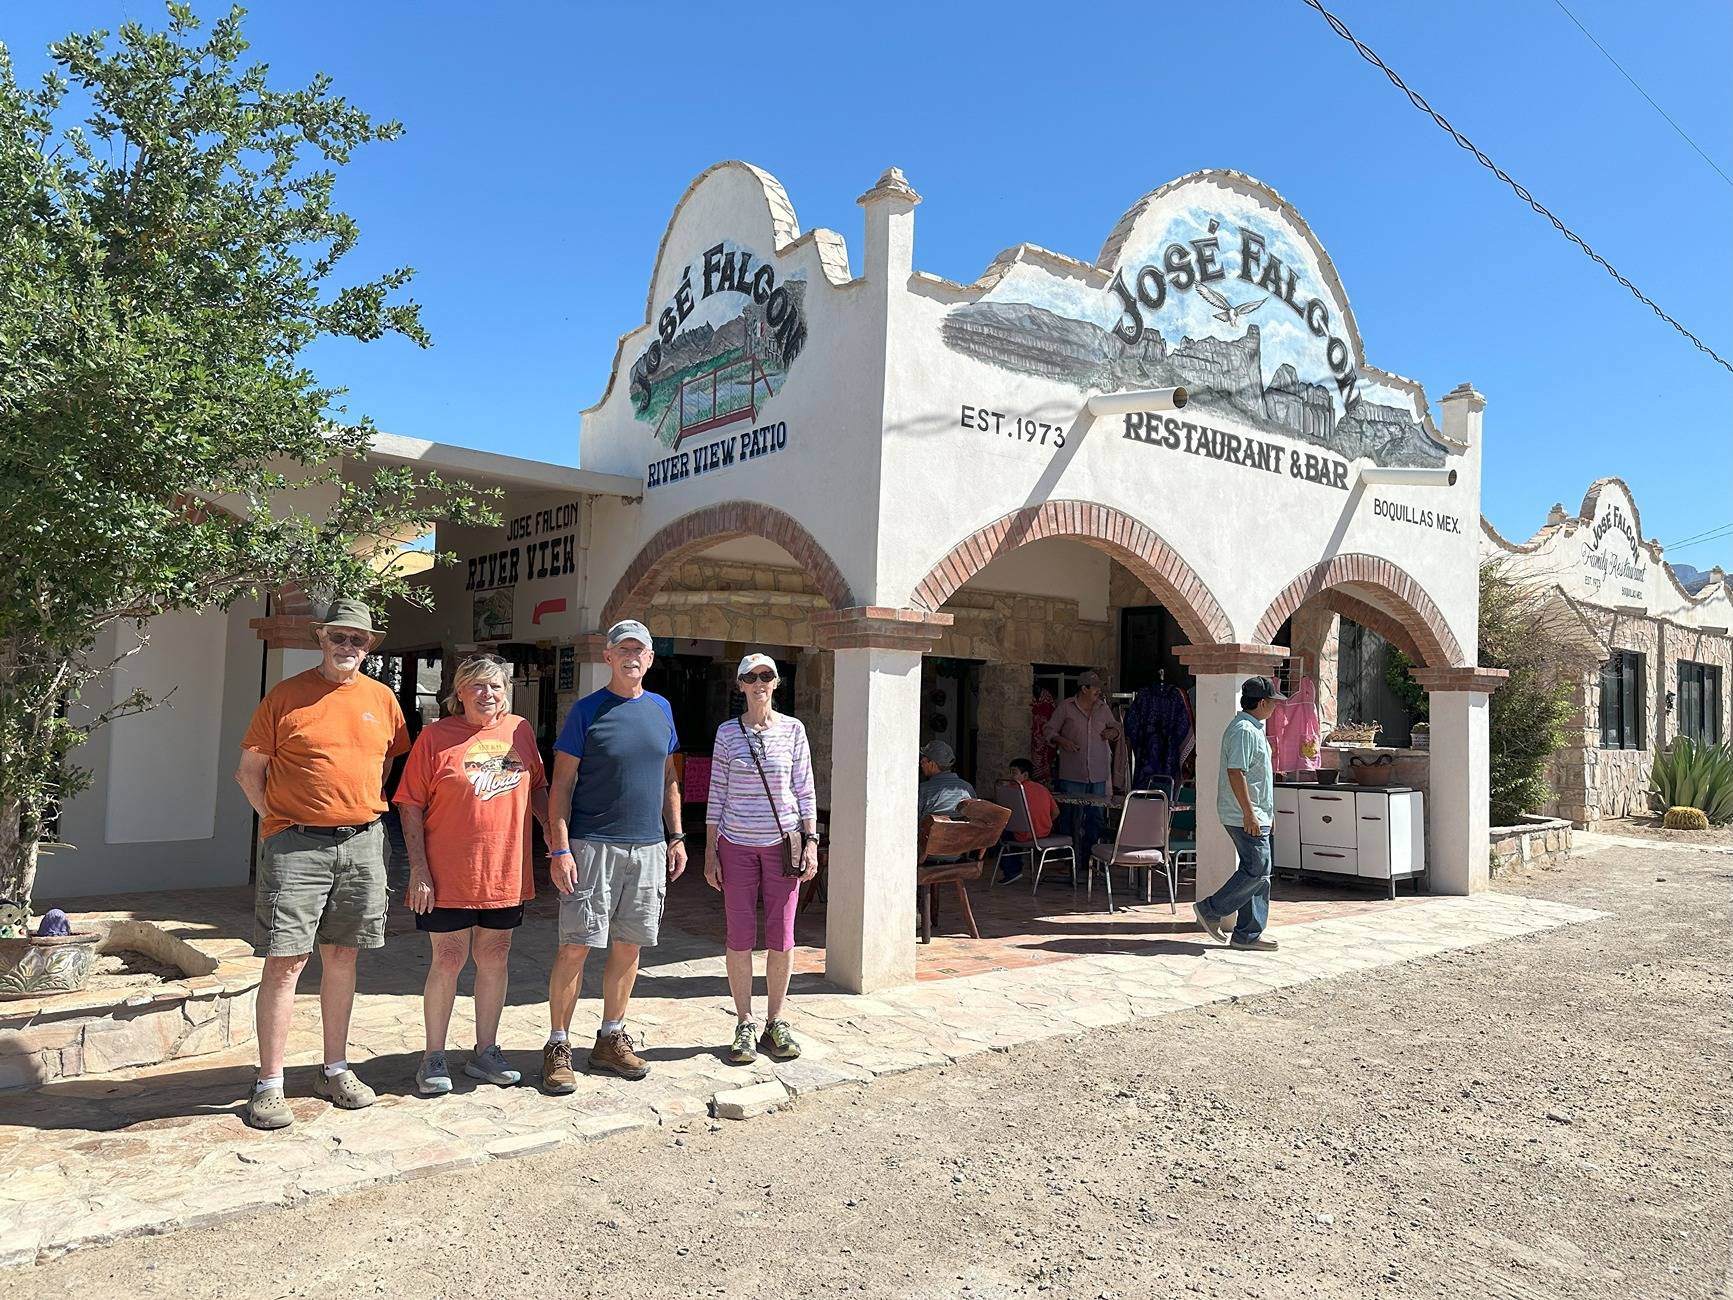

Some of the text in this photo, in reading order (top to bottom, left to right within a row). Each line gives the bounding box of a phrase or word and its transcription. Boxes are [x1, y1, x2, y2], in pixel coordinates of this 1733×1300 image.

[631, 243, 805, 411] JOSÉ FALCON
[1107, 219, 1361, 413] JOSÉ FALCON
[648, 421, 787, 488] RIVER VIEW PATIO
[1122, 411, 1286, 475] RESTAURANT
[1304, 453, 1349, 491] BAR
[507, 502, 578, 541] JOSE FALCON
[1374, 498, 1461, 534] BOQUILLAS MEX.
[1593, 503, 1640, 565] JOSÉ FALCON
[466, 534, 575, 591] RIVER VIEW
[471, 768, 521, 798] Moab
